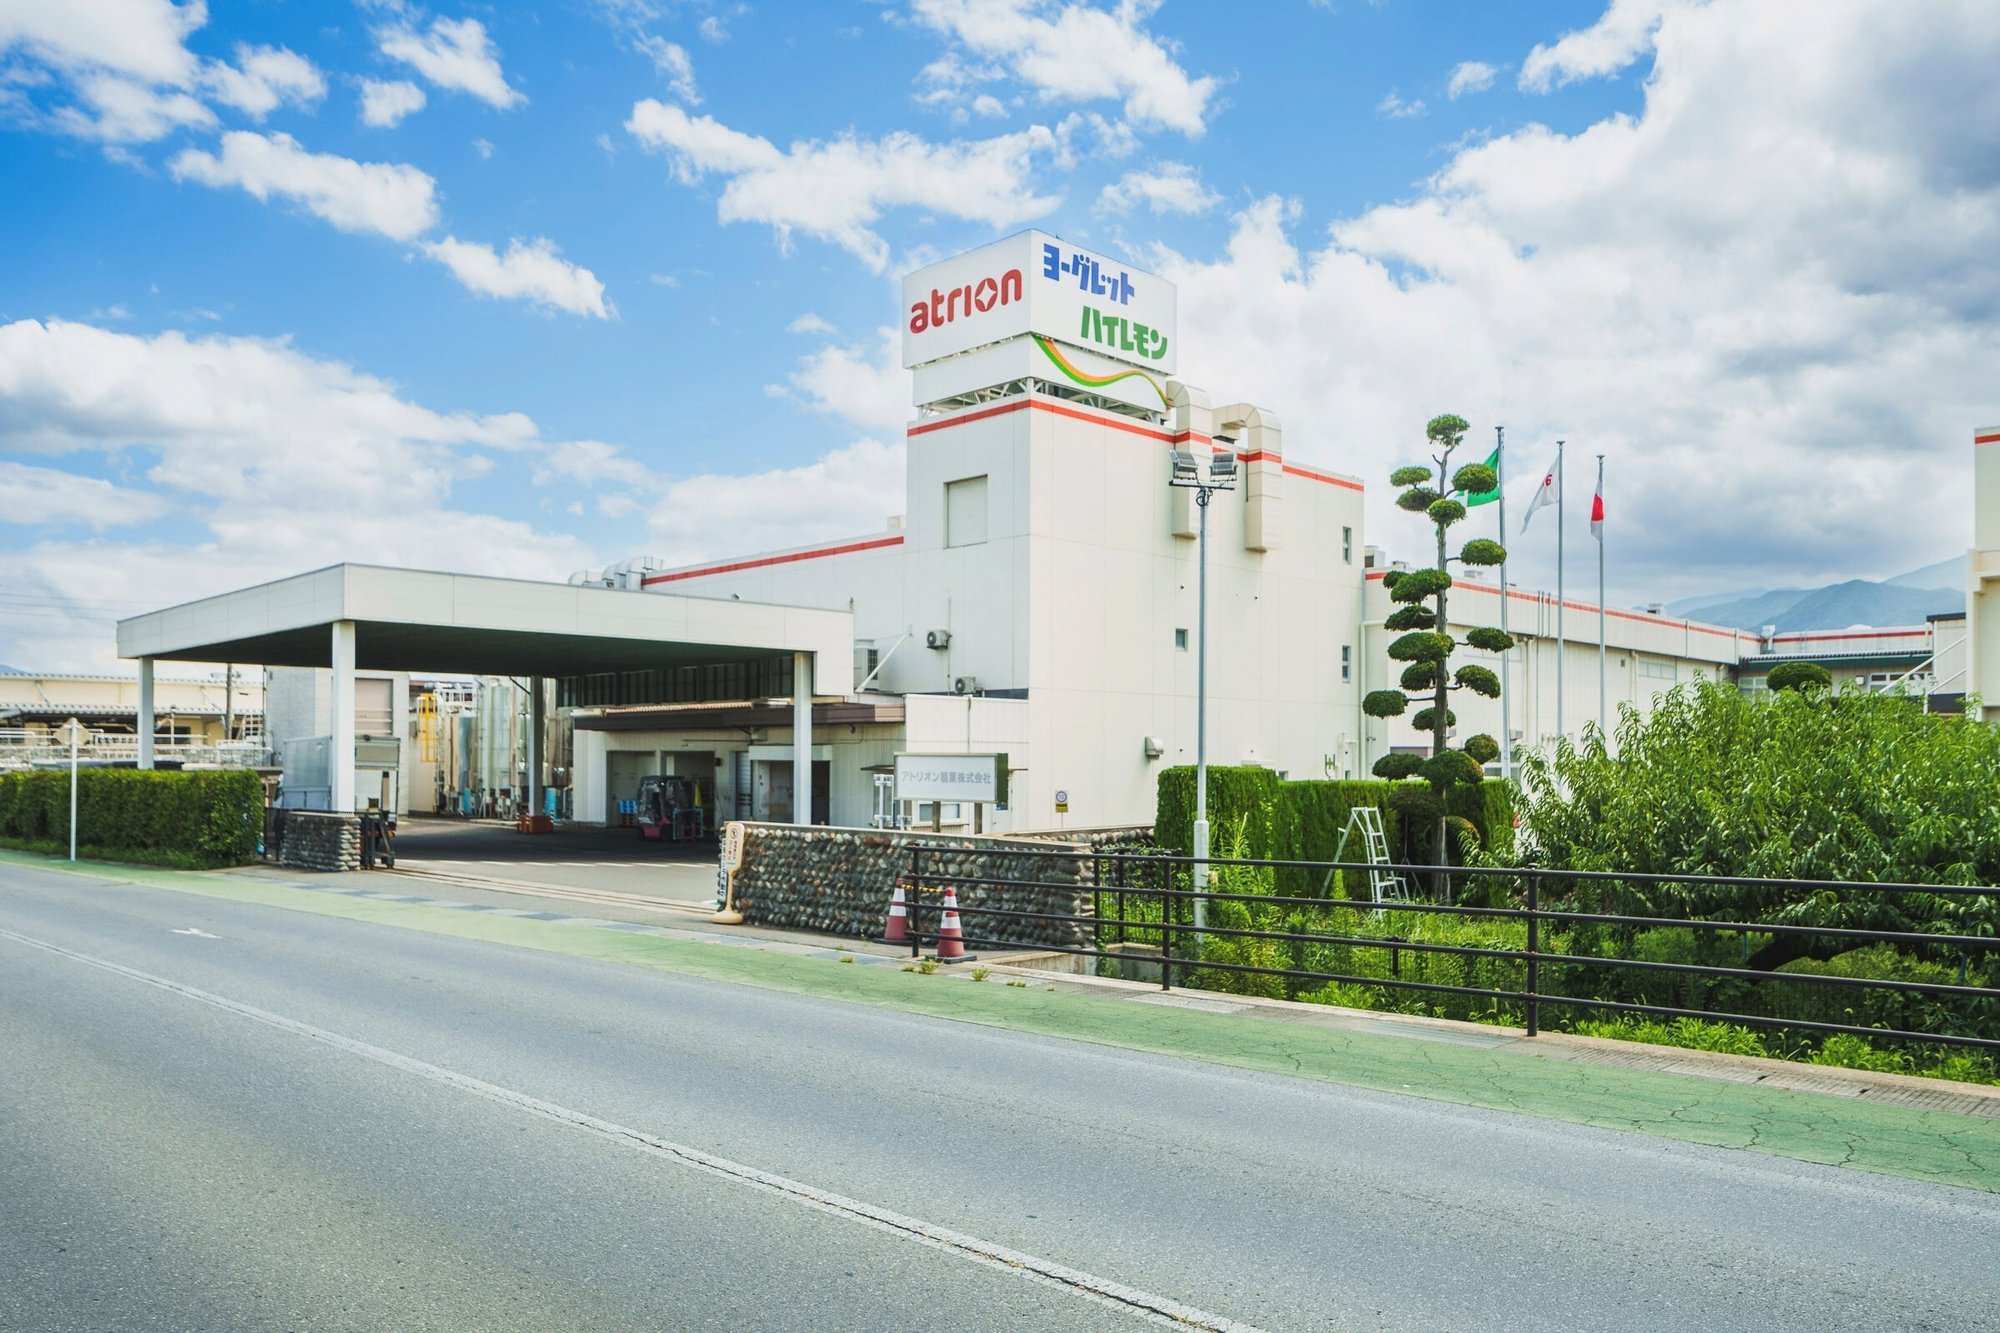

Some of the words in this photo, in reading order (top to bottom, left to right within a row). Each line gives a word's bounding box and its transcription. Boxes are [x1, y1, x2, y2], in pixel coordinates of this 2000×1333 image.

[909, 268, 1023, 334] atrion
[1043, 243, 1135, 305] ヨーグレット
[1080, 305, 1168, 360] ハイレモン
